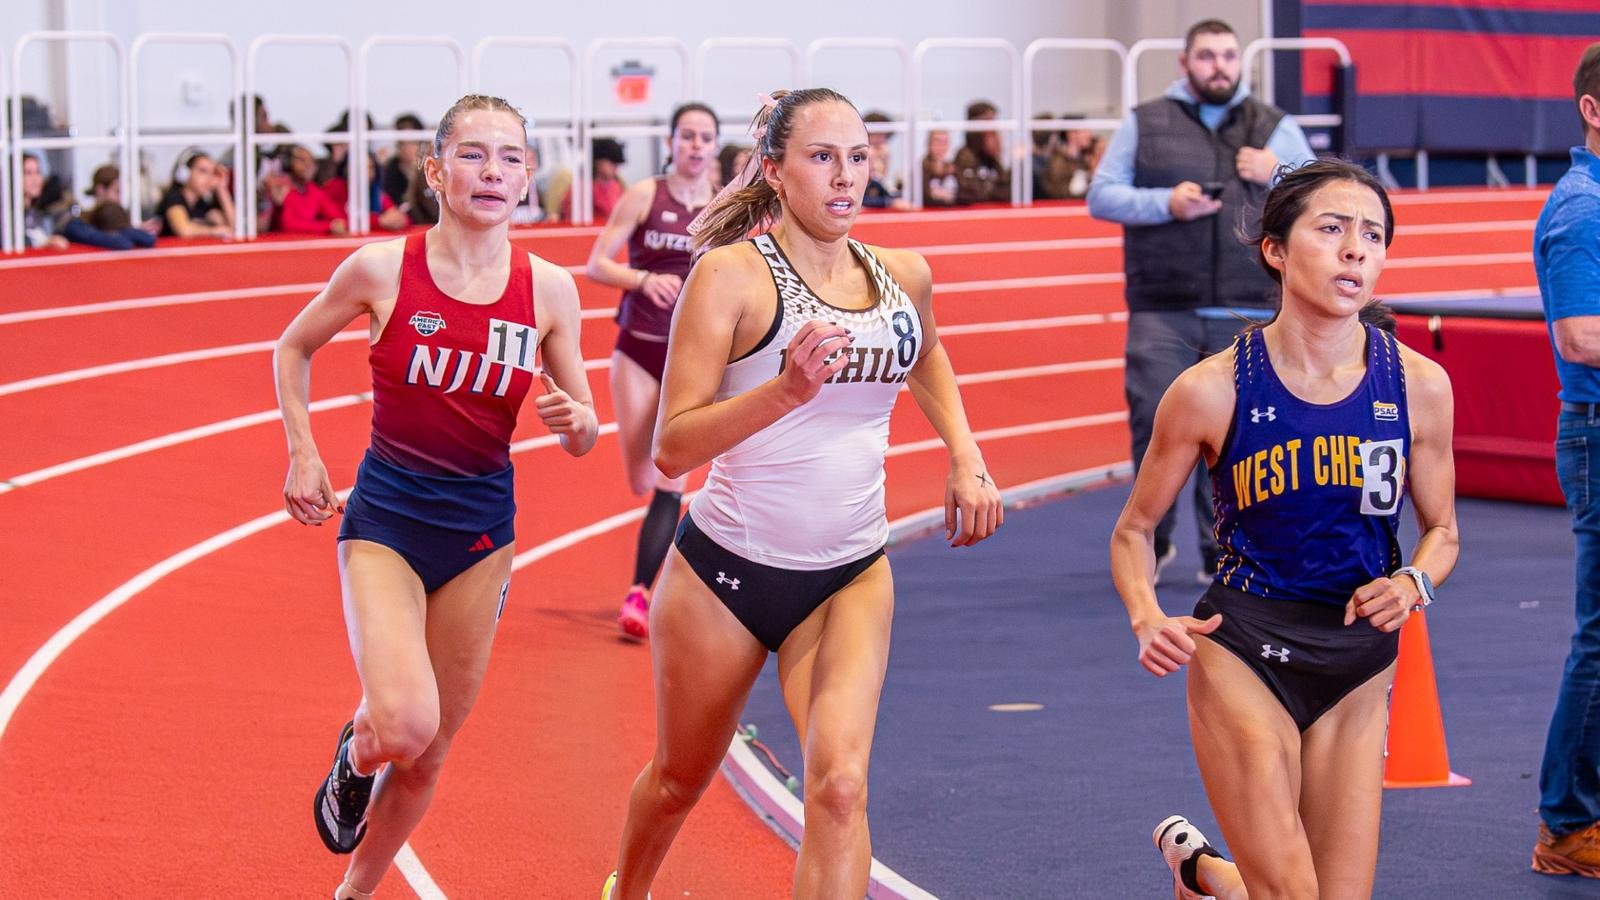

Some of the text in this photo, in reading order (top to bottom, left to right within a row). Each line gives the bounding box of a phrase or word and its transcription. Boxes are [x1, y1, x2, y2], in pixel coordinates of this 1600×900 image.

[411, 316, 445, 328] AMERICA
[493, 322, 529, 367] 11
[892, 311, 916, 368] 8
[1374, 407, 1397, 415] PSAC
[1232, 439, 1302, 511] WEST
[1368, 445, 1398, 511] 3
